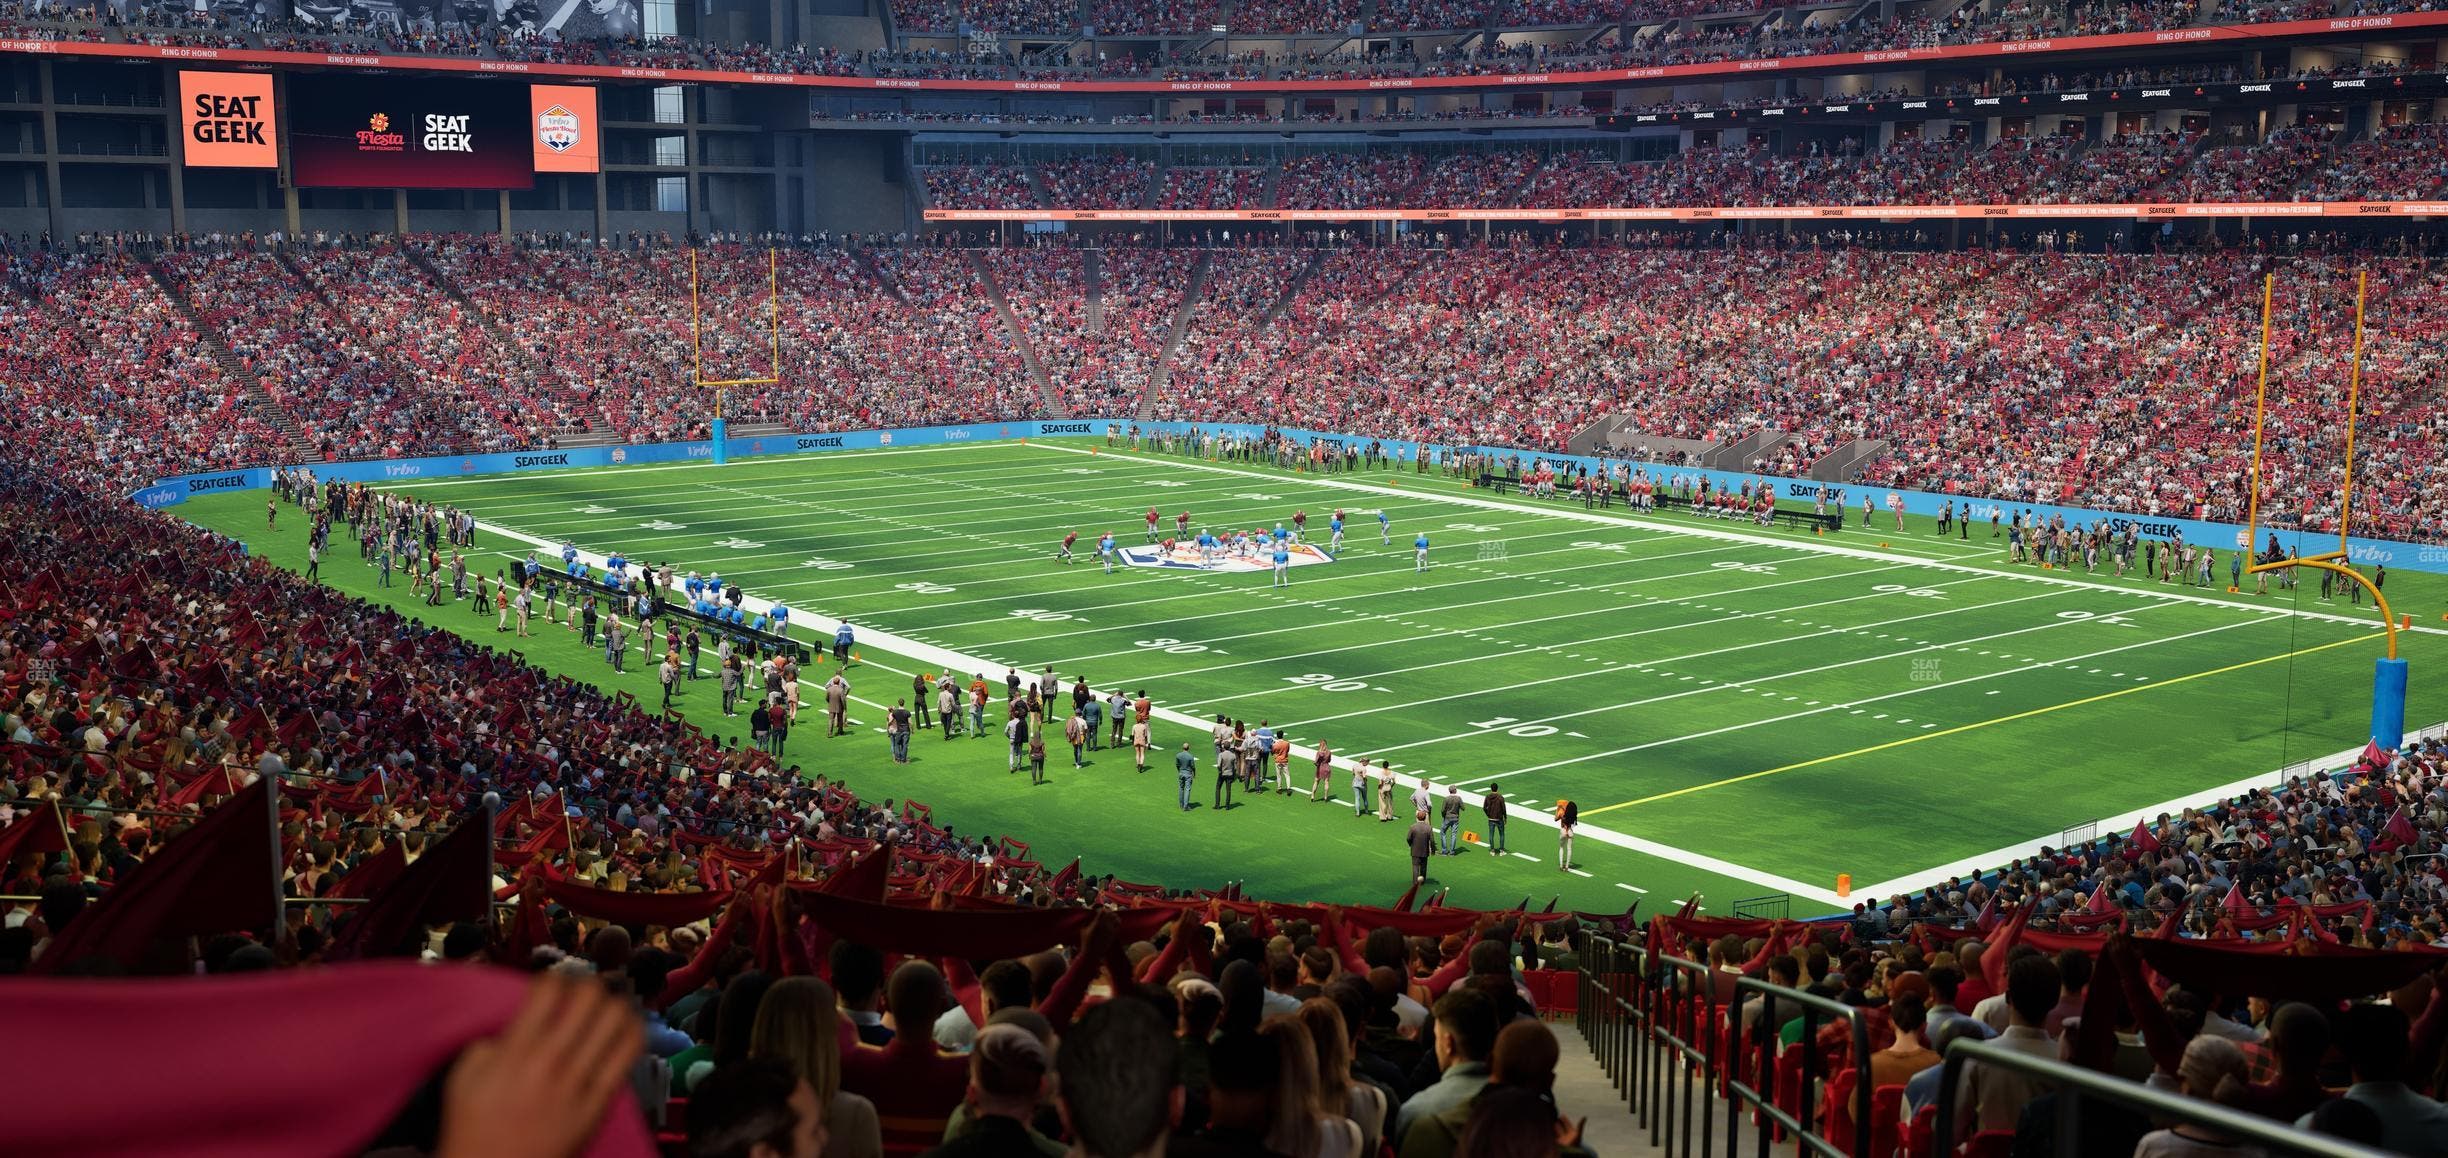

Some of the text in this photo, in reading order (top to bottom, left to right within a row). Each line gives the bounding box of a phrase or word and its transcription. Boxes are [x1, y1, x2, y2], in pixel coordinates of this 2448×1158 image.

[2331, 20, 2349, 29] RING
[2364, 17, 2392, 26] HONOR
[2157, 33, 2173, 41] RING
[2185, 30, 2211, 39] HONOR
[2, 41, 41, 50] OF HONOR
[2002, 44, 2017, 52] RING
[2028, 41, 2051, 50] HONOR
[1864, 53, 1878, 61] RING
[1887, 51, 1908, 59] HONOR
[2240, 83, 2271, 93] SEATGEEK
[2332, 79, 2365, 88] SEATGEEK
[2060, 93, 2089, 101] SEATGEEK
[2141, 89, 2171, 97] SEATGEEK
[196, 94, 261, 118] SEAT
[1902, 101, 1928, 109] SEATGEEK
[1974, 97, 2000, 106] SEATGEEK
[425, 114, 470, 133] SEAT
[194, 120, 266, 145] GEEK
[356, 131, 404, 146] Fiesta
[423, 134, 473, 152] GEEK
[1041, 422, 1091, 435] SEATGEEK
[944, 430, 970, 441] Vrbo
[797, 436, 843, 450] SEATGEEK
[515, 453, 568, 468] SEATGEEK
[384, 465, 420, 477] Vrbo
[189, 474, 246, 492] SEATGEEK
[146, 489, 177, 505] Vrbo
[2347, 544, 2393, 562] Vrbo
[1008, 609, 1073, 622] 40
[1134, 638, 1208, 653] 30
[1282, 673, 1368, 692] 20
[1467, 716, 1559, 738] 10
